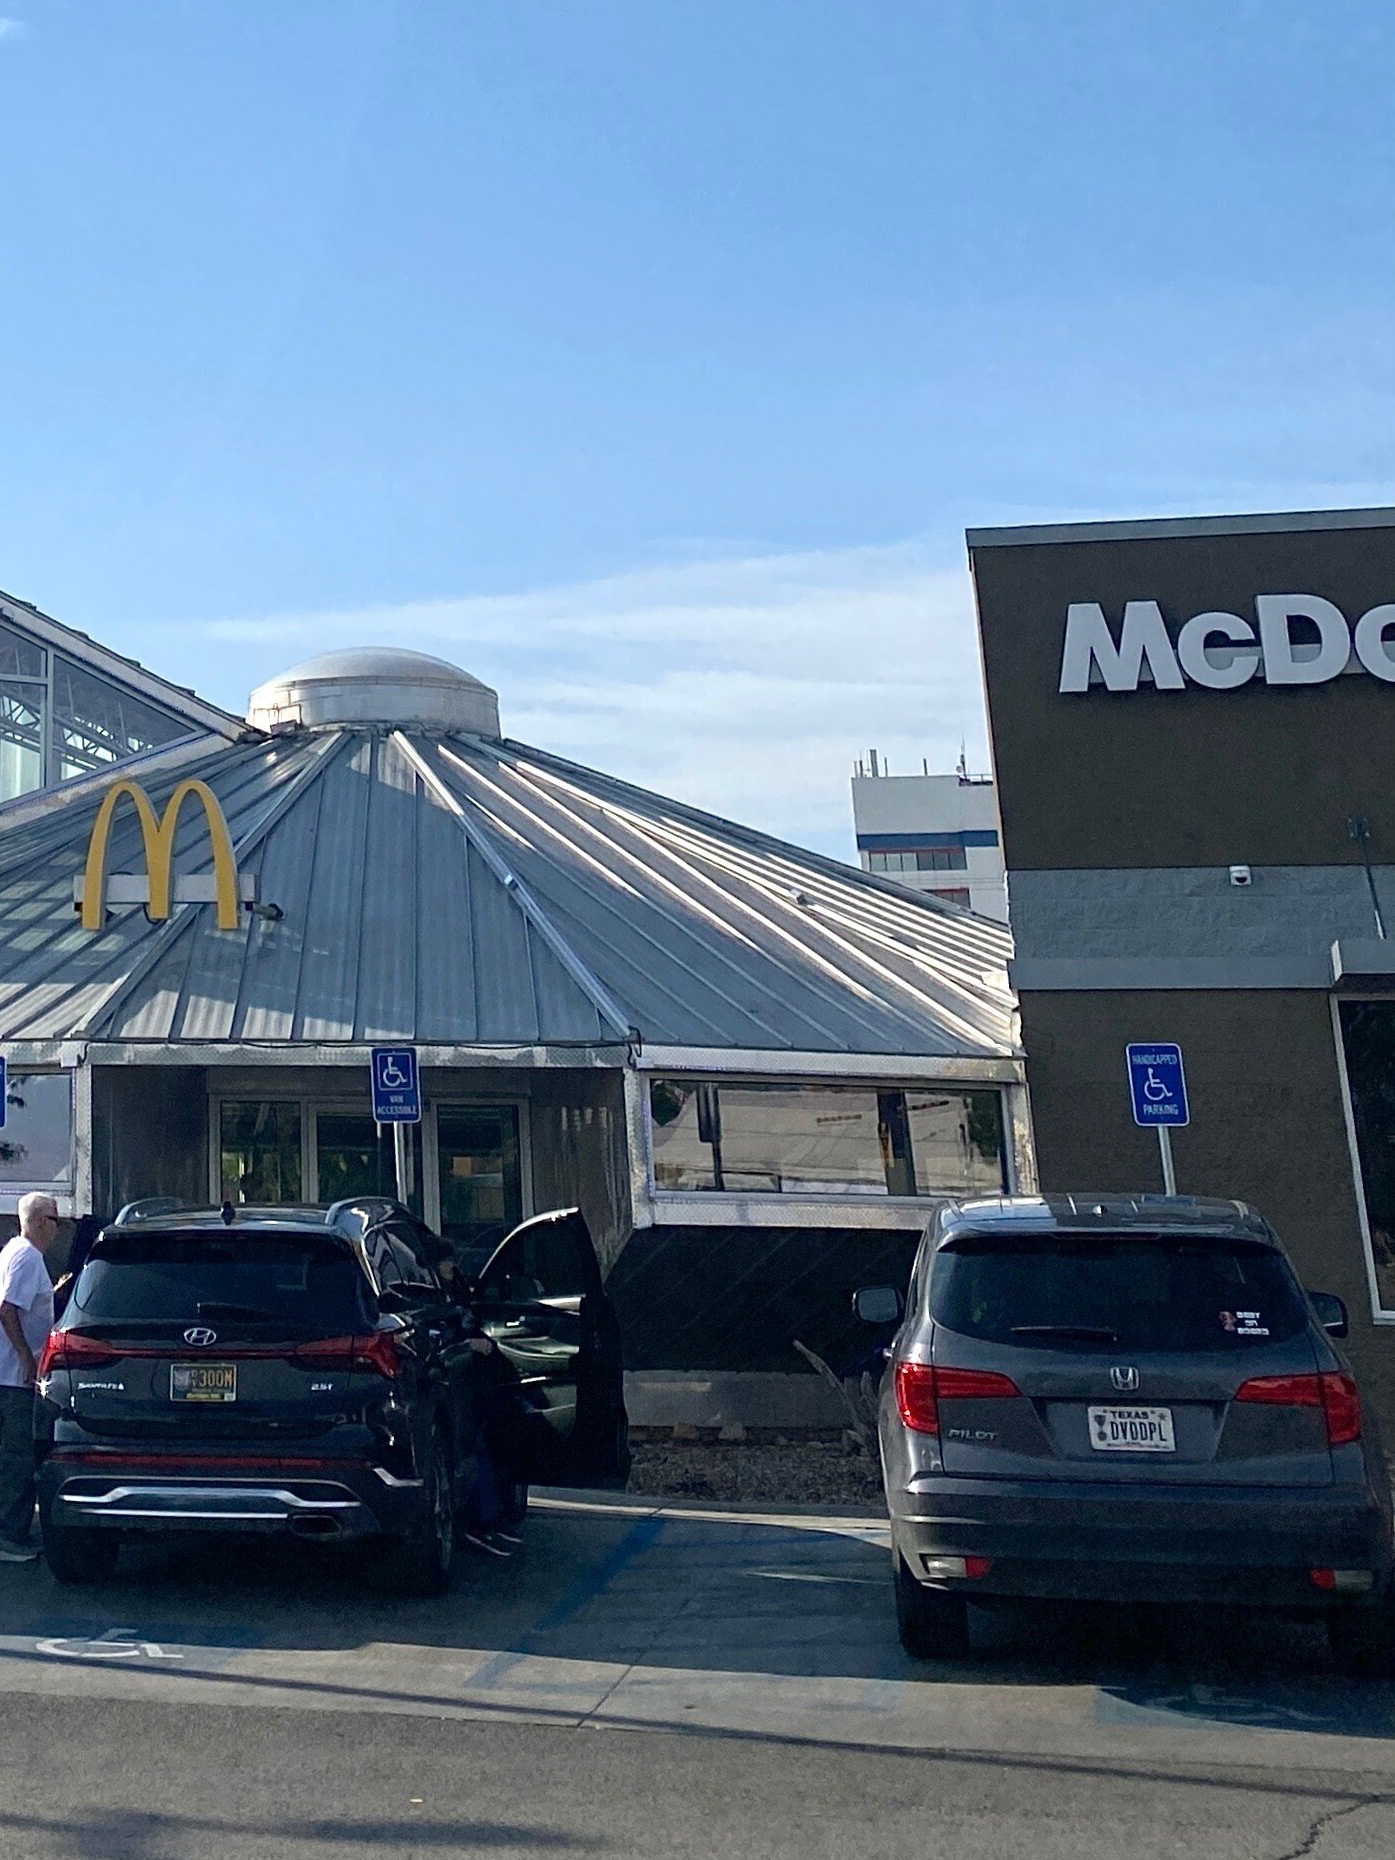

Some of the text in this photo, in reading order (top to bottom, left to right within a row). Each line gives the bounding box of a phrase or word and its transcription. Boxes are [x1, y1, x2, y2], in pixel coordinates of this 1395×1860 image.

[1132, 1054, 1178, 1065] HANDICAPPED
[389, 1095, 404, 1103] VAN
[377, 1105, 417, 1115] ACCESSIBLE
[1143, 1104, 1179, 1116] PARKING
[1110, 1410, 1149, 1420] TEXAS
[949, 1429, 997, 1440] PILOT
